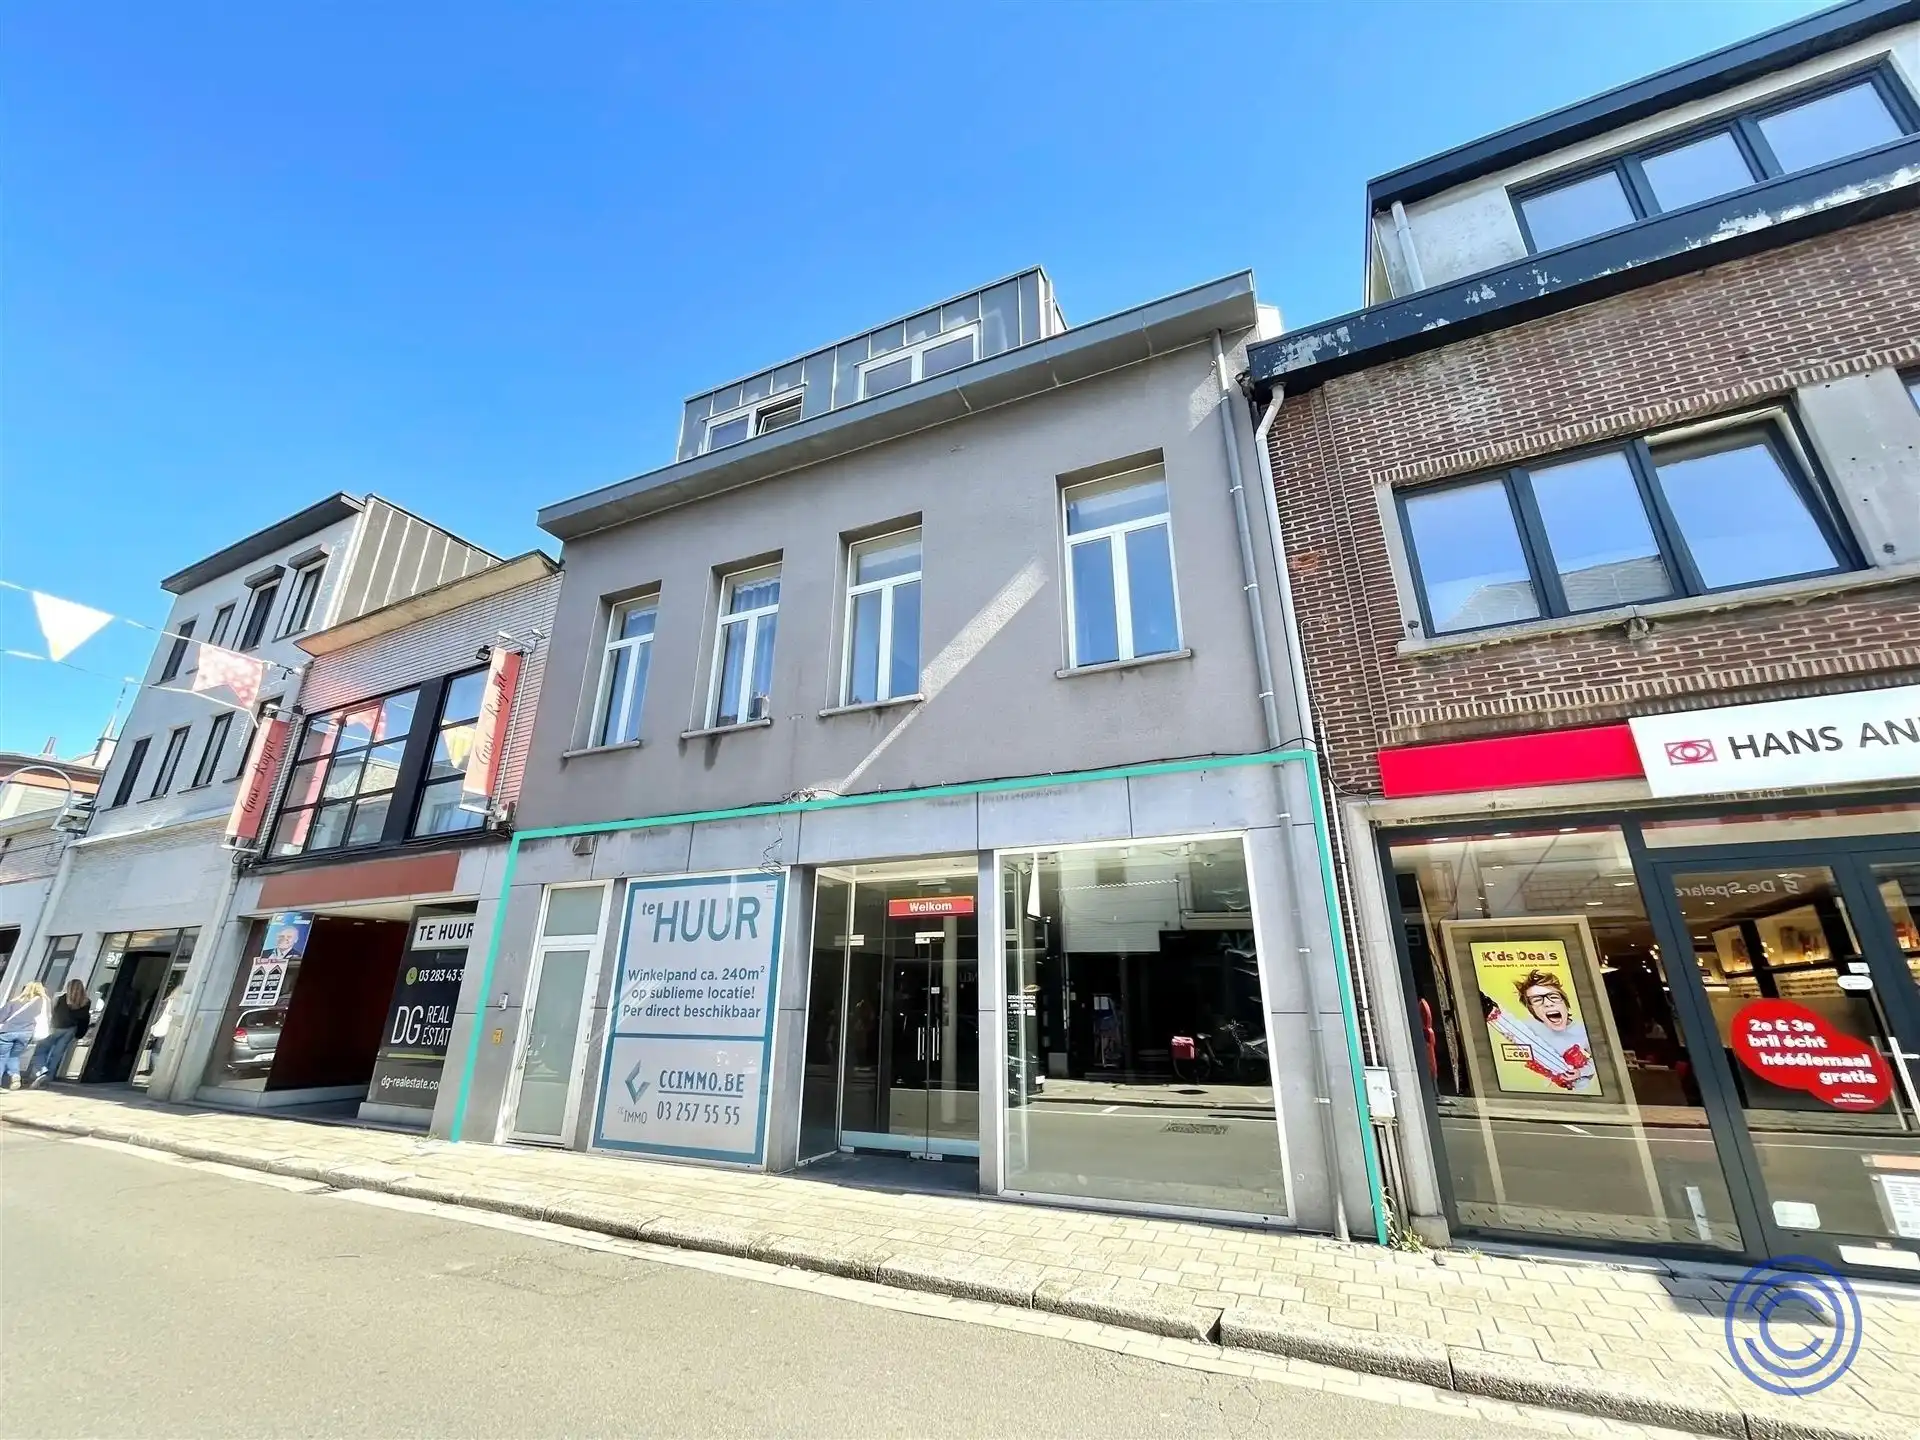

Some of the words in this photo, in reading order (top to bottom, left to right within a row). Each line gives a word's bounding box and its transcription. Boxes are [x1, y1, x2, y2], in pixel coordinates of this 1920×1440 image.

[1727, 726, 1843, 760] HANS
[1860, 716, 1920, 748] AN
[252, 739, 276, 779] Royal
[909, 902, 952, 912] Welkom
[642, 901, 655, 916] te
[653, 897, 761, 943] HUUR
[419, 925, 436, 941] TE
[438, 923, 474, 940] HUUR
[1482, 951, 1514, 962] Kids
[418, 969, 429, 982] 03
[429, 969, 446, 982] 283
[447, 969, 458, 981] 43
[628, 968, 697, 983] Winkelpand
[700, 970, 718, 981] ca.
[631, 988, 647, 999] op
[650, 987, 703, 999] sublieme
[707, 987, 755, 999] locatie!
[426, 1005, 450, 1024] REAL
[623, 1005, 642, 1017] Per
[645, 1005, 680, 1017] direct
[684, 1005, 761, 1018] beschikbaar
[390, 1005, 424, 1045] DG
[1749, 1019, 1773, 1032] 2e
[1775, 1020, 1789, 1032] &
[1791, 1019, 1816, 1032] 3e
[1747, 1034, 1781, 1047] bril
[659, 1070, 745, 1092] CCIMMO.BE
[1819, 1070, 1878, 1085] gratis
[623, 1111, 648, 1124] IMMO
[657, 1101, 672, 1121] 03
[676, 1102, 700, 1122] 257
[704, 1104, 719, 1124] 55
[725, 1106, 740, 1126] 55
